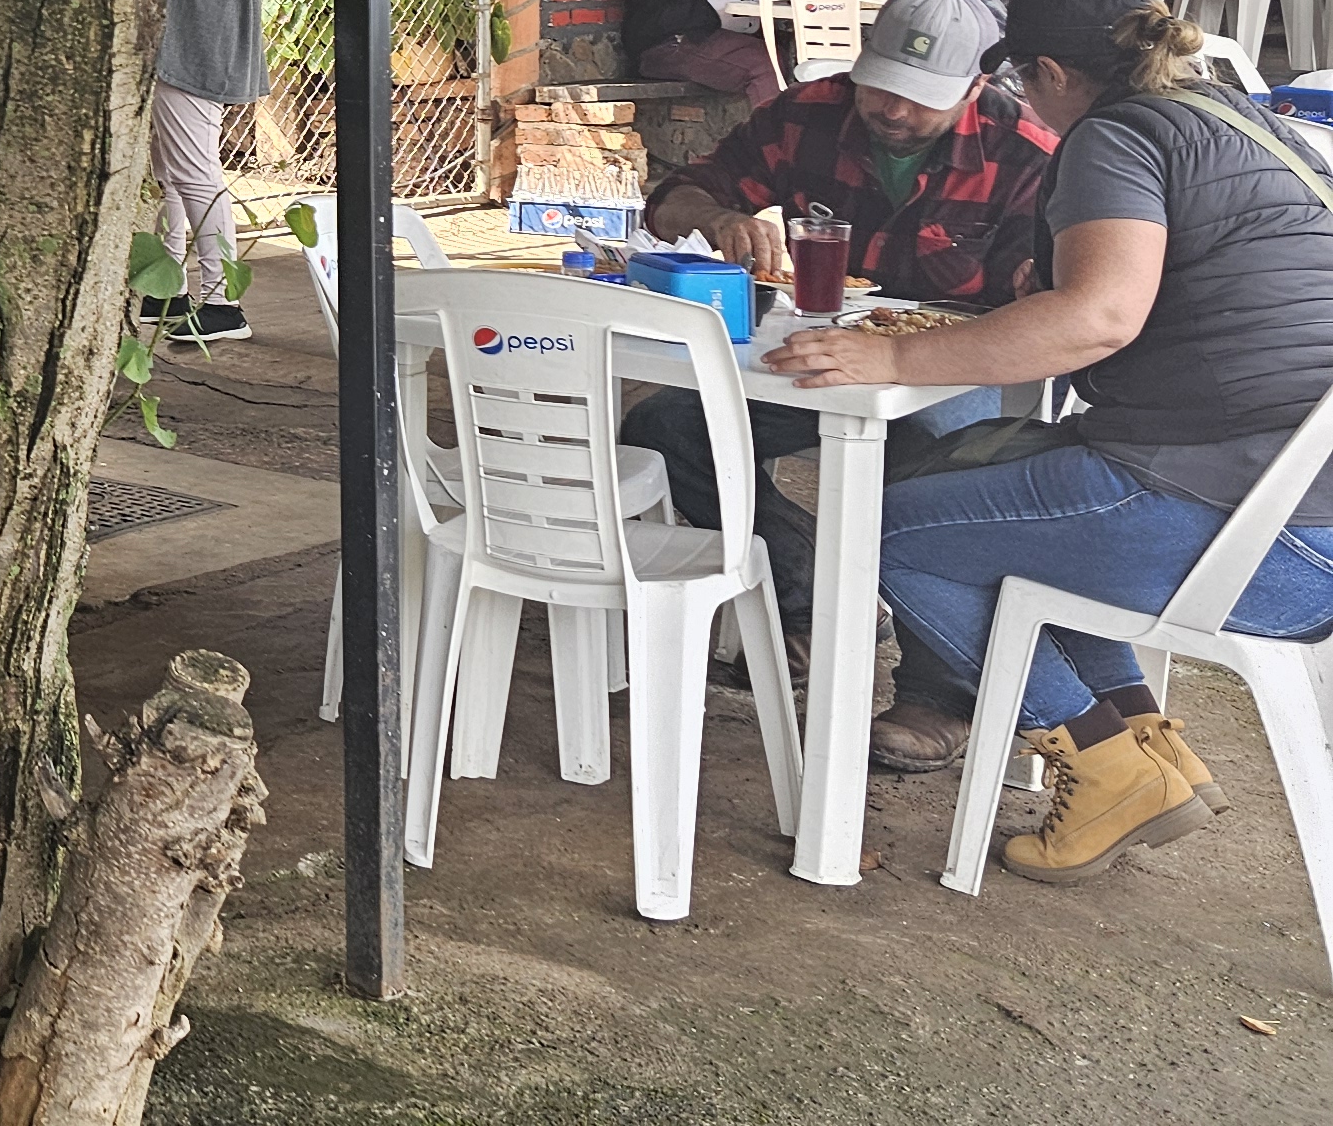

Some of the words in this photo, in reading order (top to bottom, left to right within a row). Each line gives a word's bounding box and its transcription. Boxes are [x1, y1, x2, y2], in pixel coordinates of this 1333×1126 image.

[563, 213, 605, 229] pepsi
[708, 289, 725, 310] psi
[507, 334, 575, 355] pepsi
